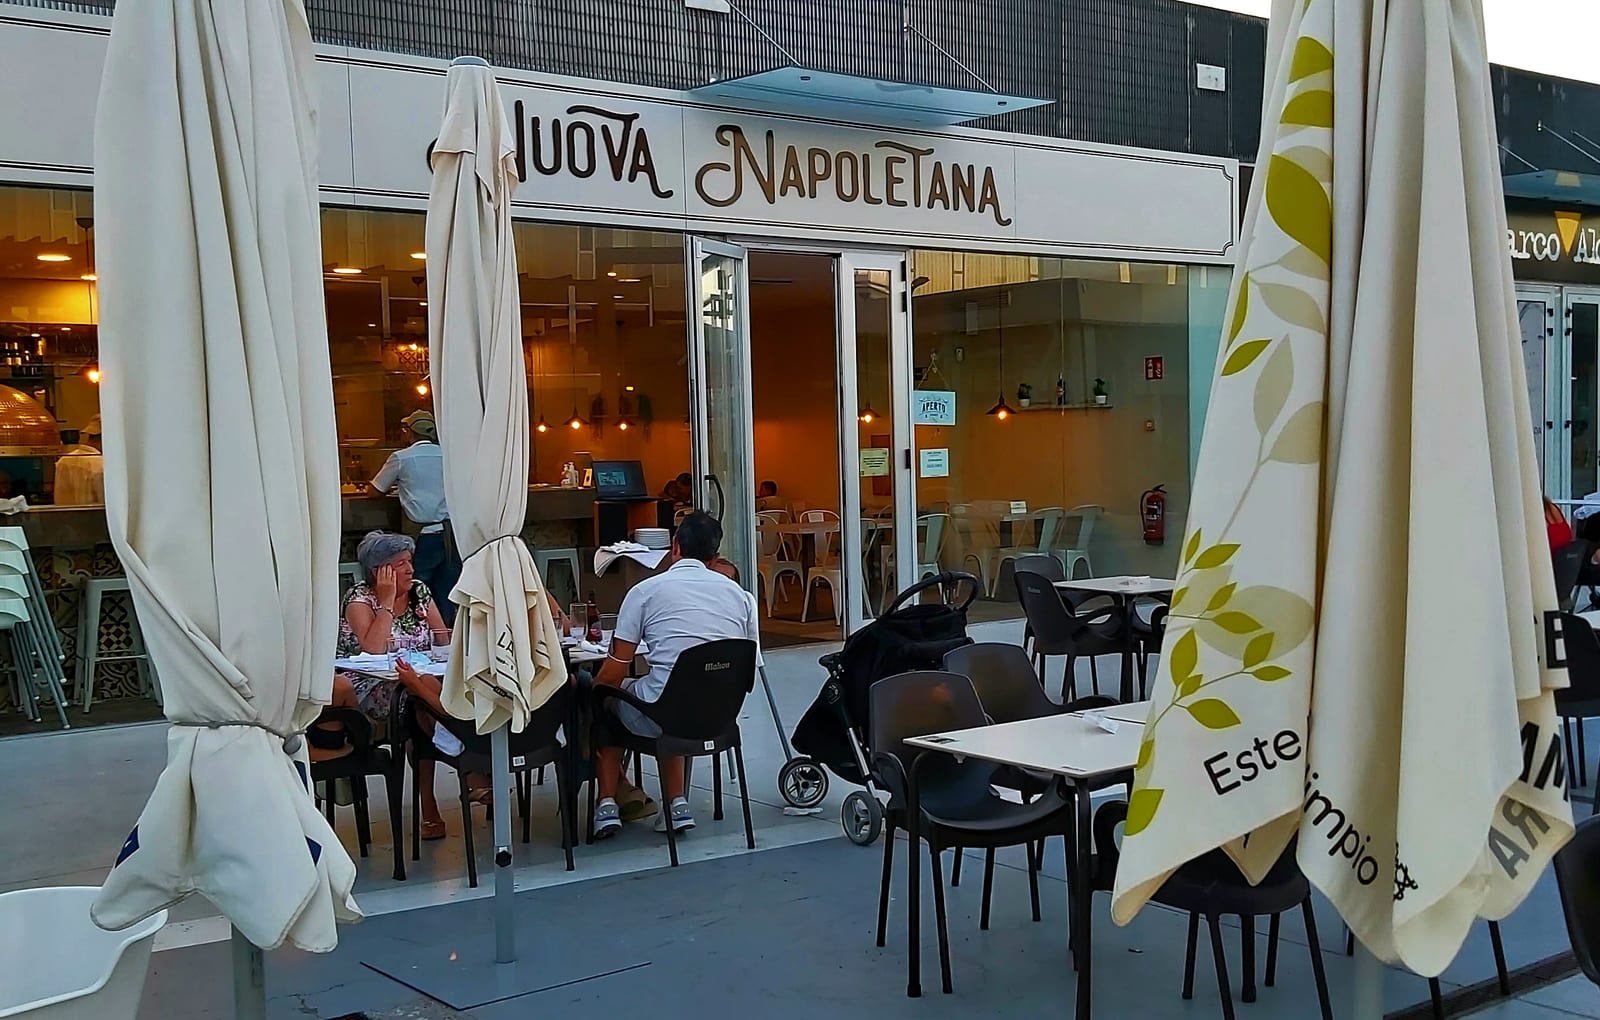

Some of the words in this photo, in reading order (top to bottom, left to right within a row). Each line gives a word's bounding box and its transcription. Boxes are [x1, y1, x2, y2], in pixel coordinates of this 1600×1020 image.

[695, 124, 1012, 227] NAPOLETANA
[922, 401, 946, 413] APERTO
[1203, 729, 1302, 796] Este
[1304, 763, 1379, 886] impio
